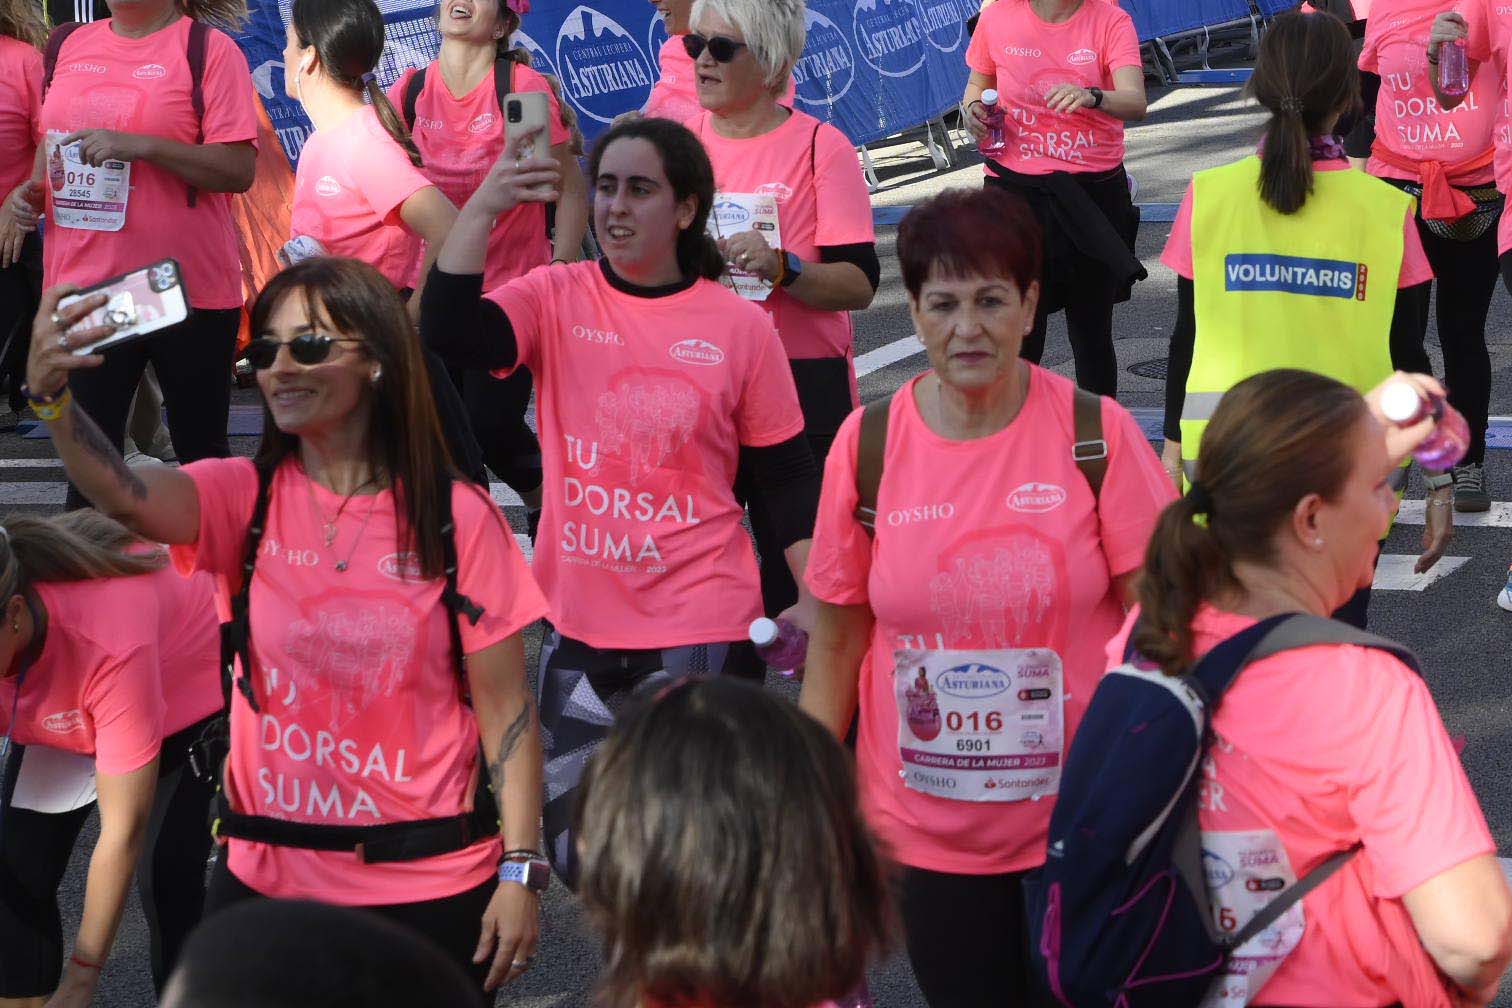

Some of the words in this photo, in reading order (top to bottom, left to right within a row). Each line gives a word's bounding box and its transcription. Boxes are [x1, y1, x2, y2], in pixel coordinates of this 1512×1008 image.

[1005, 47, 1042, 58] OYSHO
[565, 54, 650, 99] ASTURIANA
[1388, 71, 1412, 92] TU
[1394, 92, 1479, 118] DORAL
[1397, 122, 1461, 144] SUMA
[67, 171, 96, 186] 016
[1227, 263, 1354, 290] VOLUNTARIS
[564, 433, 599, 470] TU
[564, 477, 701, 524] DORSAL
[888, 502, 955, 527] OYSHO
[561, 520, 662, 563] SUMA
[943, 677, 998, 690] ASTURIANA
[946, 710, 1003, 732] 016
[261, 714, 412, 782] DORSAL
[956, 738, 991, 752] 6901
[914, 754, 955, 767] CARRERA
[957, 757, 971, 767] DE
[972, 758, 985, 768] LA
[987, 757, 1021, 767] MUJER
[914, 771, 957, 789] OYSHO
[998, 775, 1050, 789] Santander
[258, 766, 382, 819] SUMA
